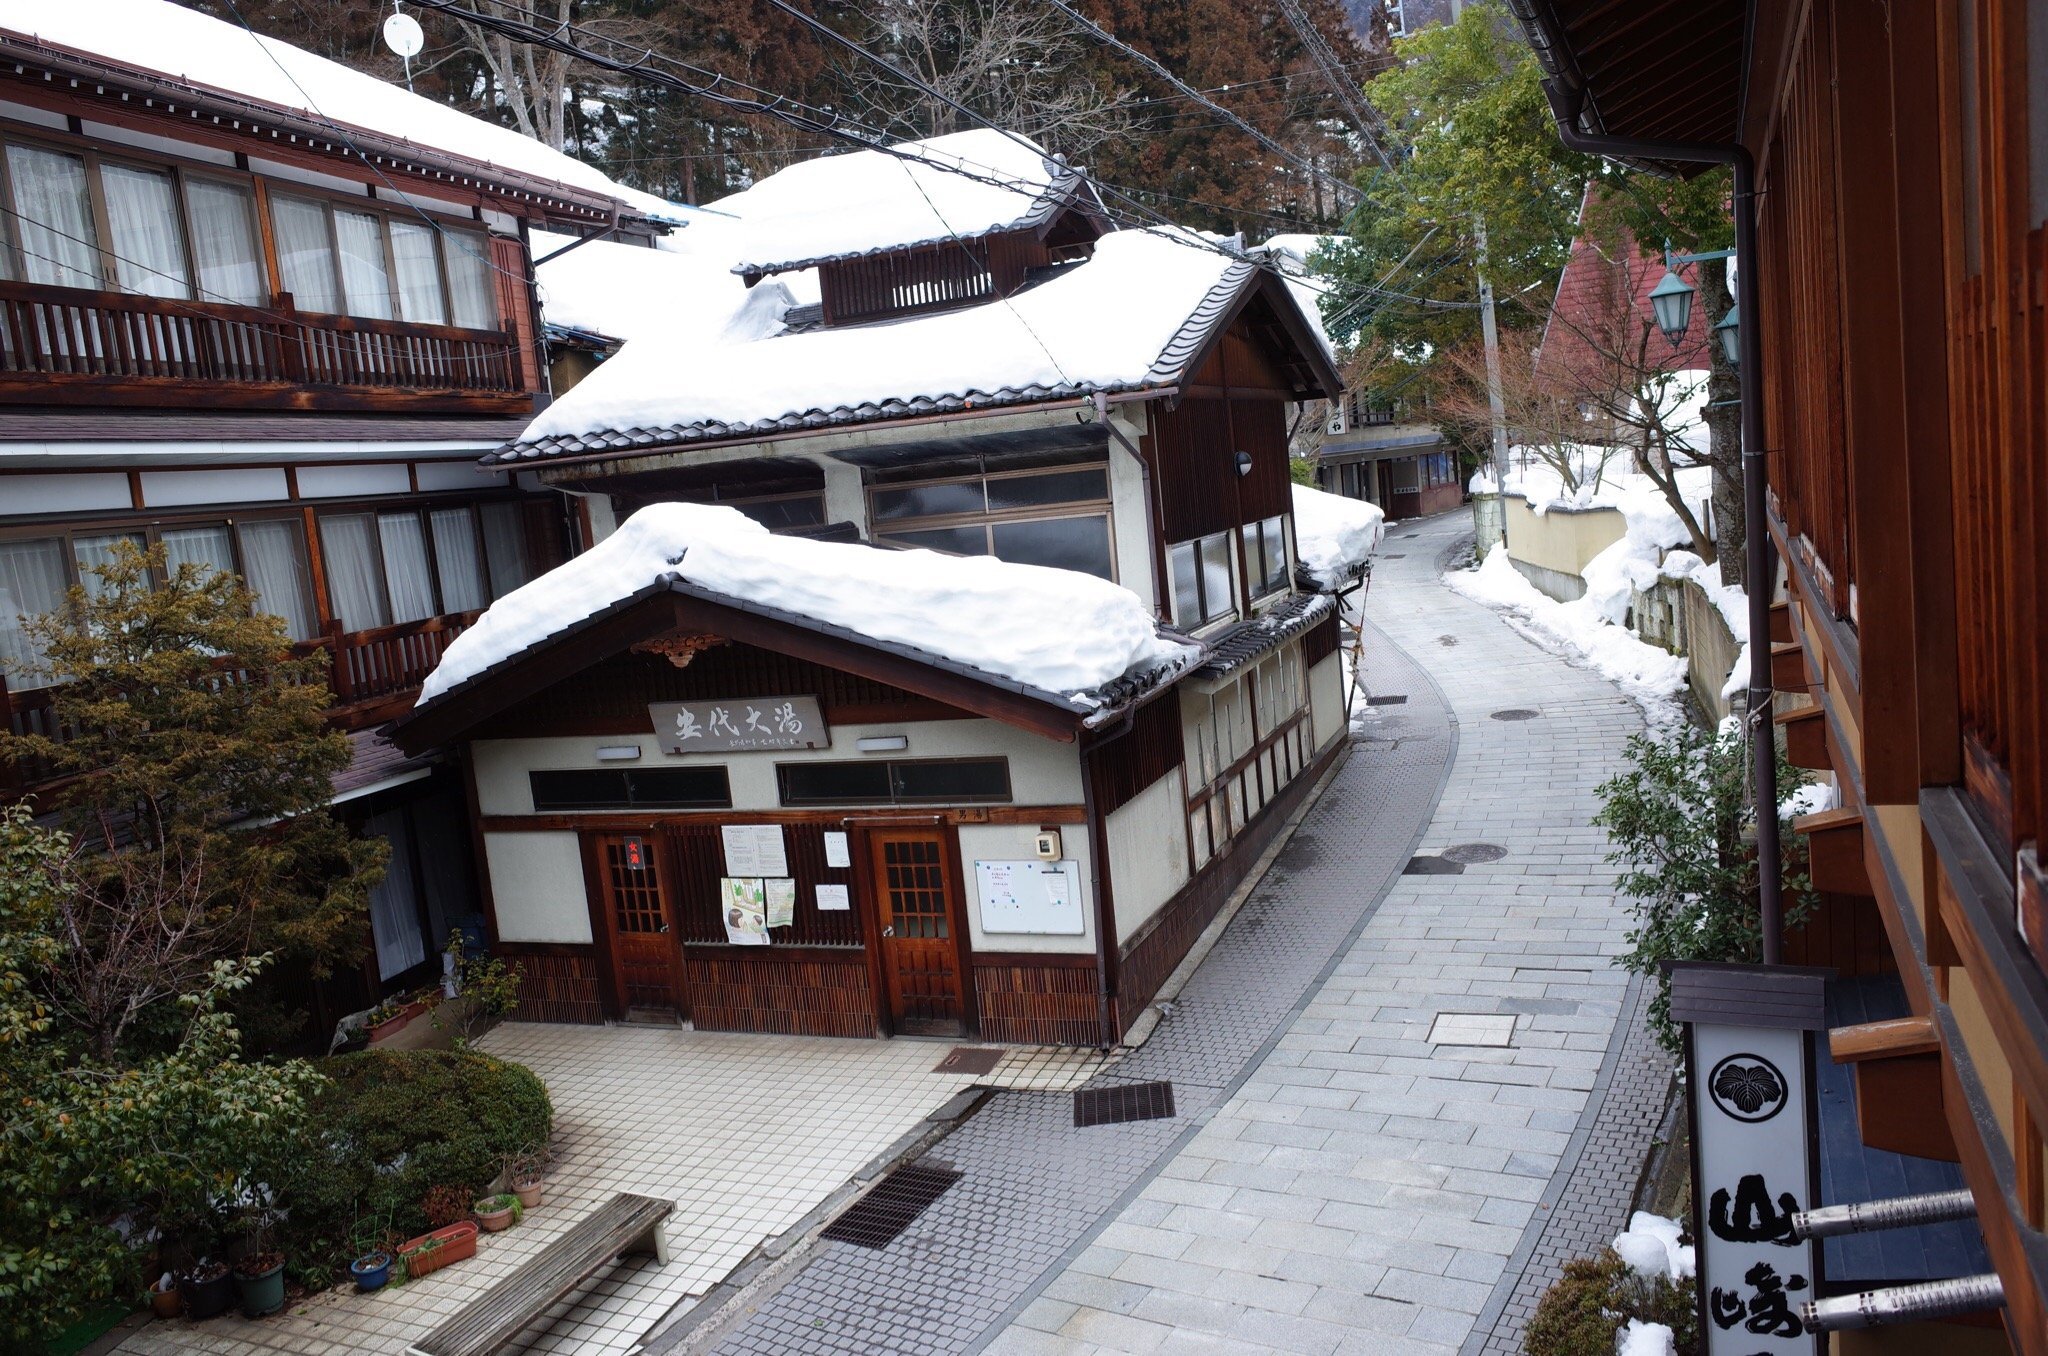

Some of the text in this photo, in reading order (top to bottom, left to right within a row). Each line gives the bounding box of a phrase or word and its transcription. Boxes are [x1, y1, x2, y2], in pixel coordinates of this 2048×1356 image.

[675, 702, 803, 740] 安代大湯
[958, 808, 983, 821] 男湯
[628, 840, 641, 864] 女湯
[1708, 1173, 1809, 1356] 山崎
